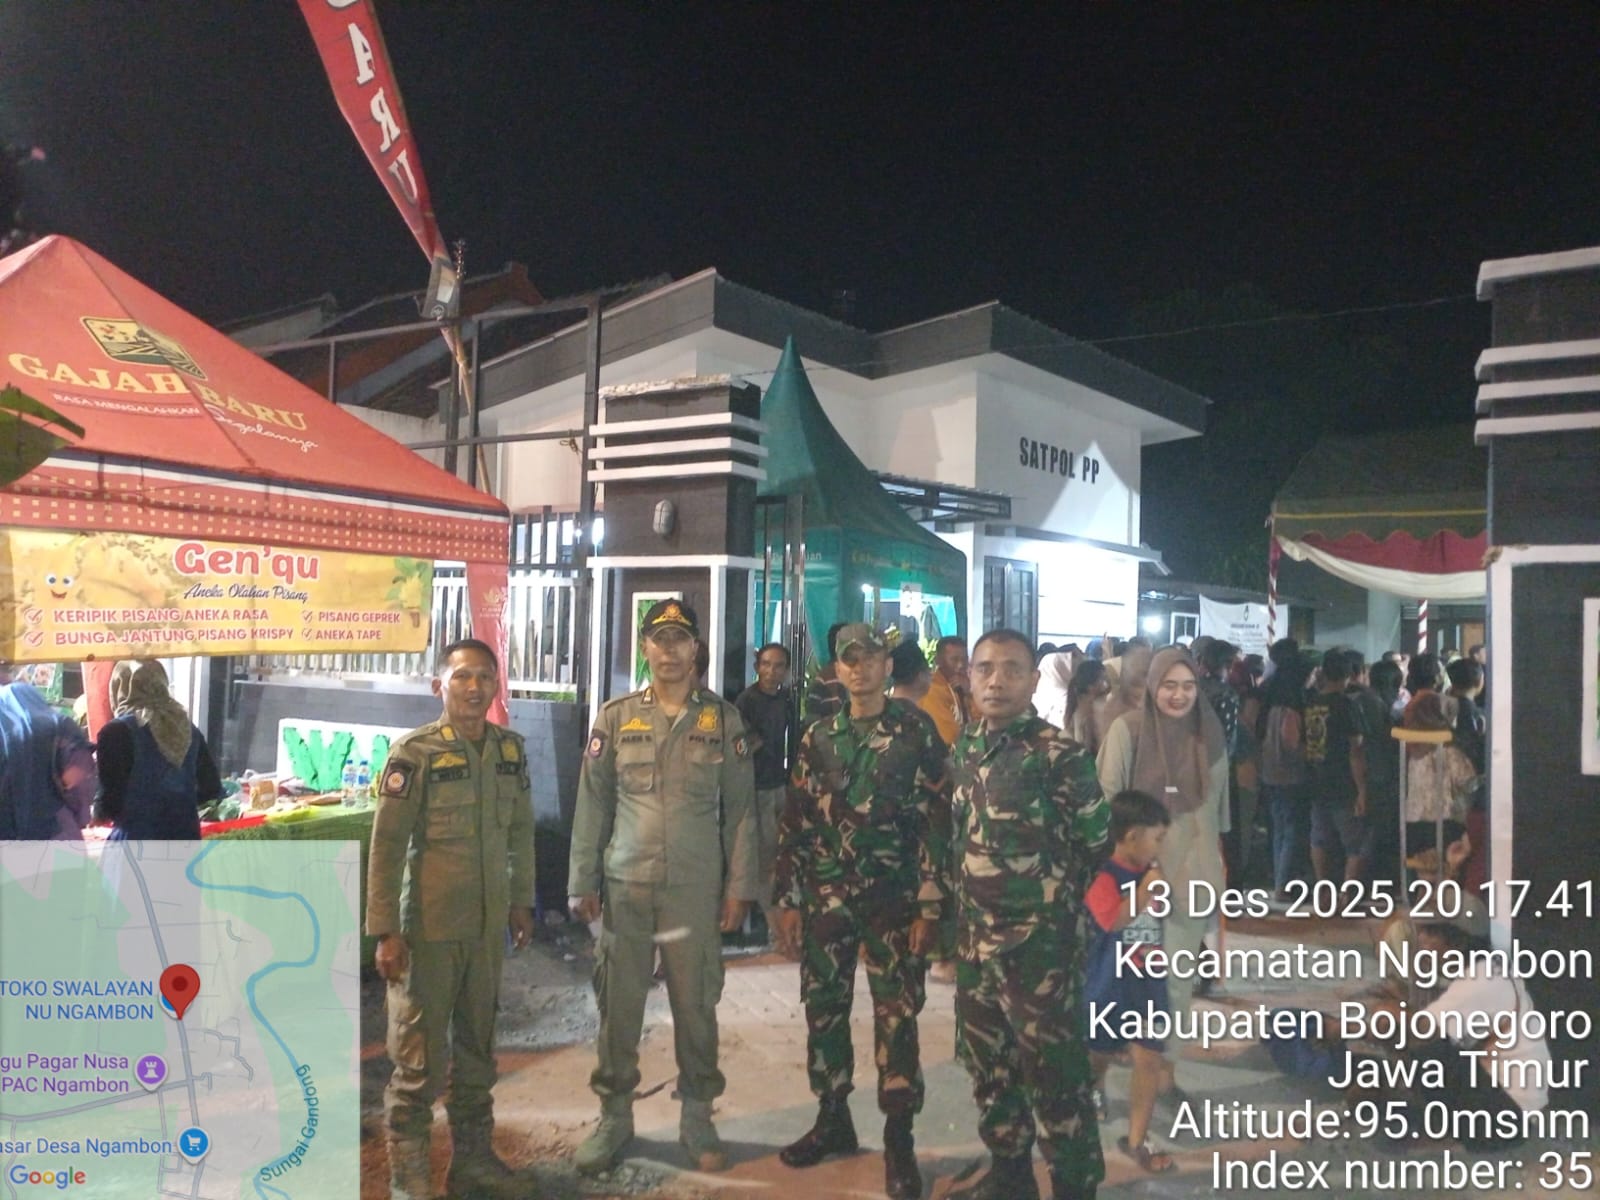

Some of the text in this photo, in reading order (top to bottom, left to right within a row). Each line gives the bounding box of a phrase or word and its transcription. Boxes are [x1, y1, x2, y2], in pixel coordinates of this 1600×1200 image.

[8, 352, 307, 431] GAJAH BARU
[1019, 436, 1100, 485] SATPOL PP
[184, 582, 309, 605] Aneka Olahan Pisang
[54, 608, 269, 624] KERIPIK PISANG ANEKA RASA
[318, 611, 400, 624] PISANG GEPREK
[56, 627, 294, 645] BUNGA JANTUNG PISANG KRISPY
[315, 629, 382, 641] ANEKA TAPE
